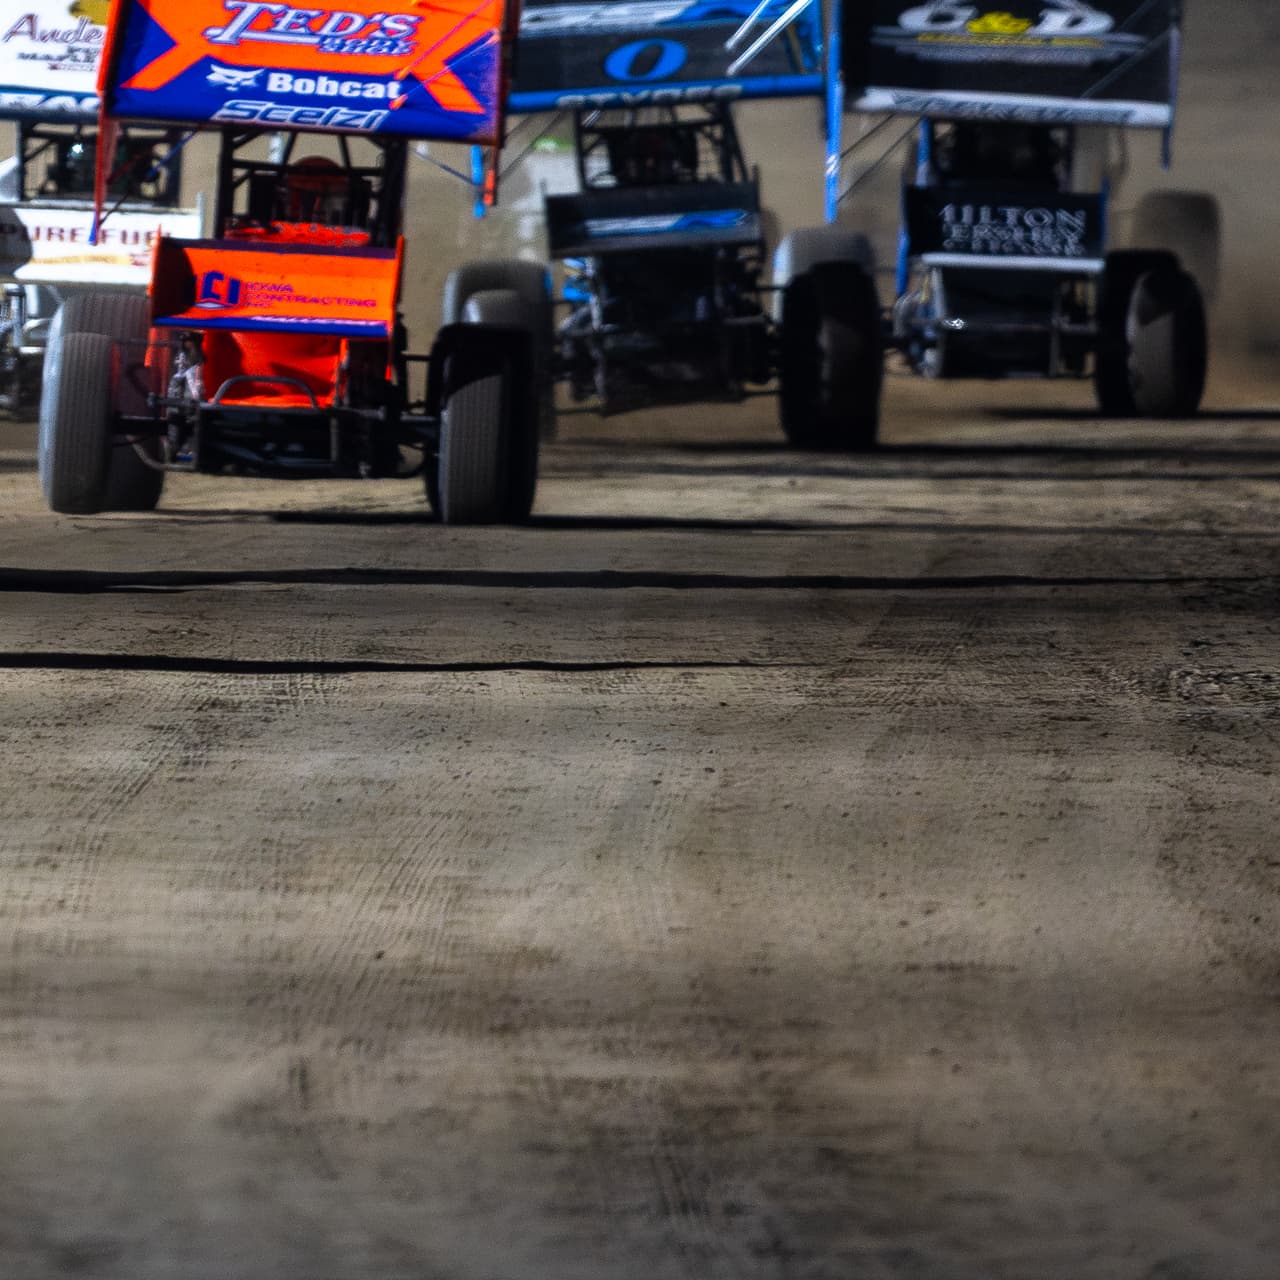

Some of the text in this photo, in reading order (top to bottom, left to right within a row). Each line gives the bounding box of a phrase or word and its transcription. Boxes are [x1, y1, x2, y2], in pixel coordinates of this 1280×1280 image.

[2, 13, 104, 43] Ande
[267, 73, 400, 99] Bobcat
[244, 293, 378, 308] CONTRACTING
